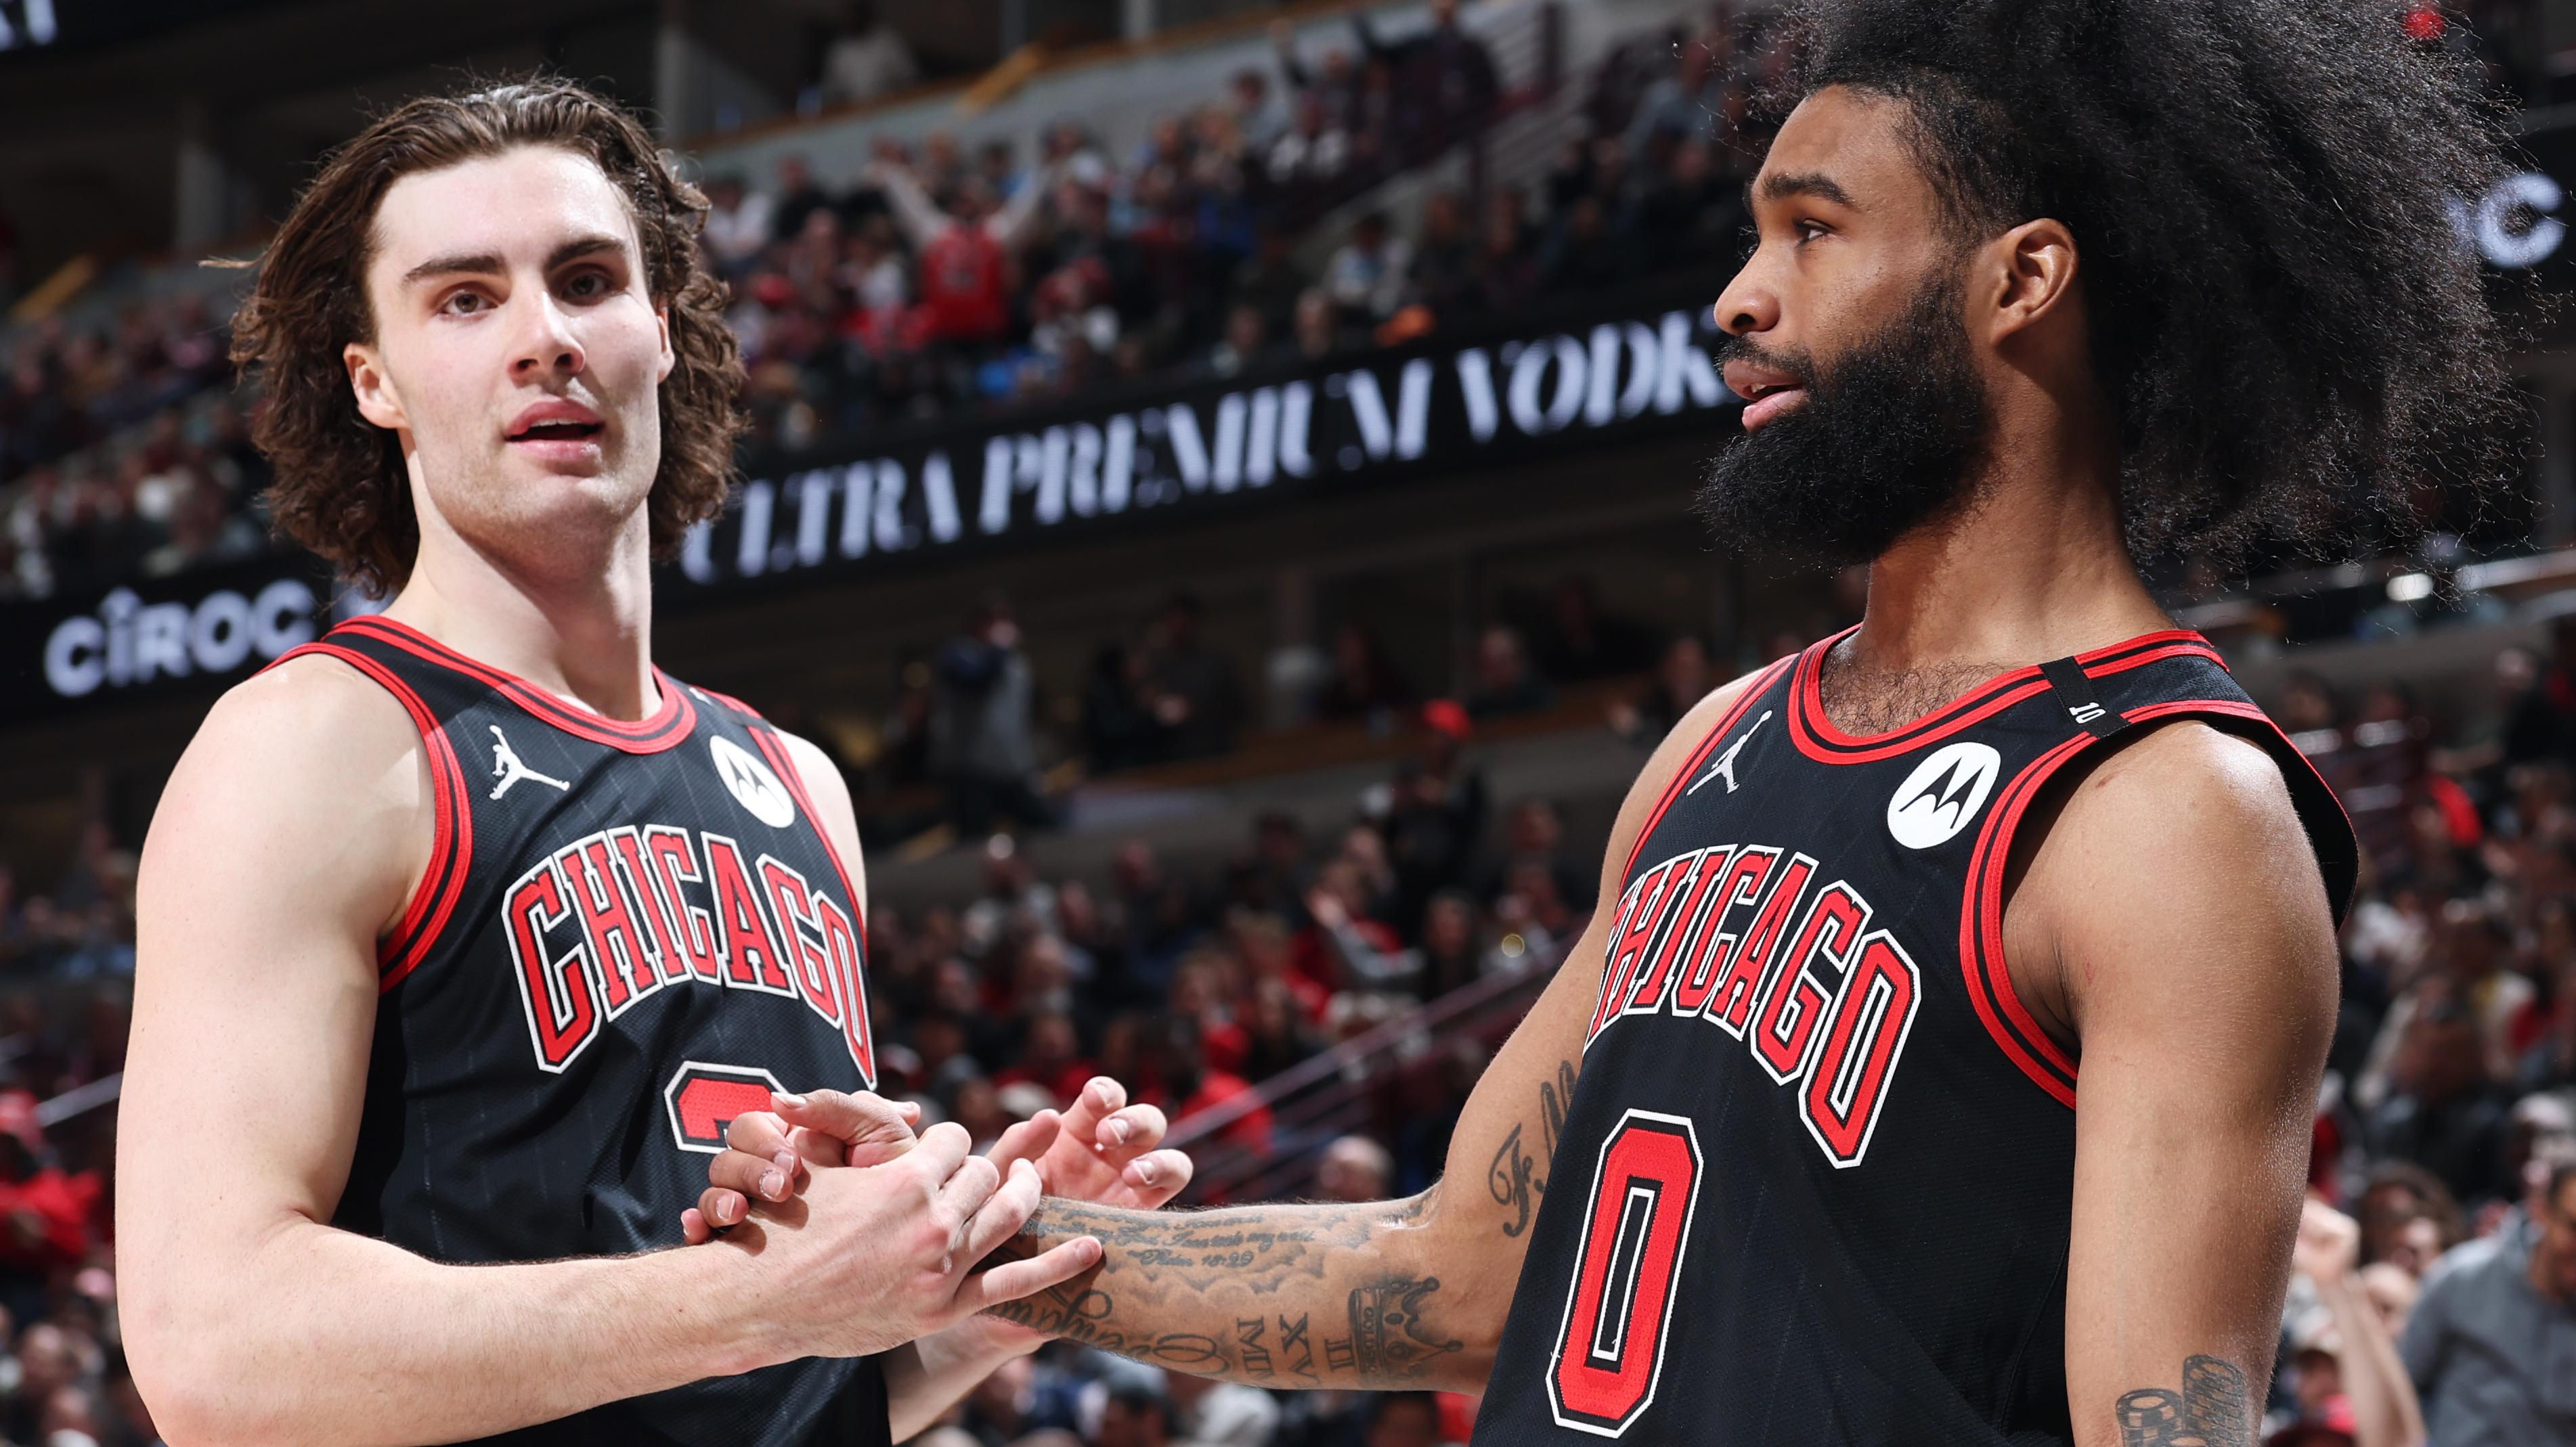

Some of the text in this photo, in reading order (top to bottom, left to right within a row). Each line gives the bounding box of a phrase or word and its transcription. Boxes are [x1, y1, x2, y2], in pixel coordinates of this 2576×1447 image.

[980, 358, 1433, 534] PREMIUM
[1456, 309, 1726, 444] VODK
[2069, 702, 2106, 724] 10
[502, 824, 877, 1090] CHICAGO
[1546, 1107, 1704, 1439] 0
